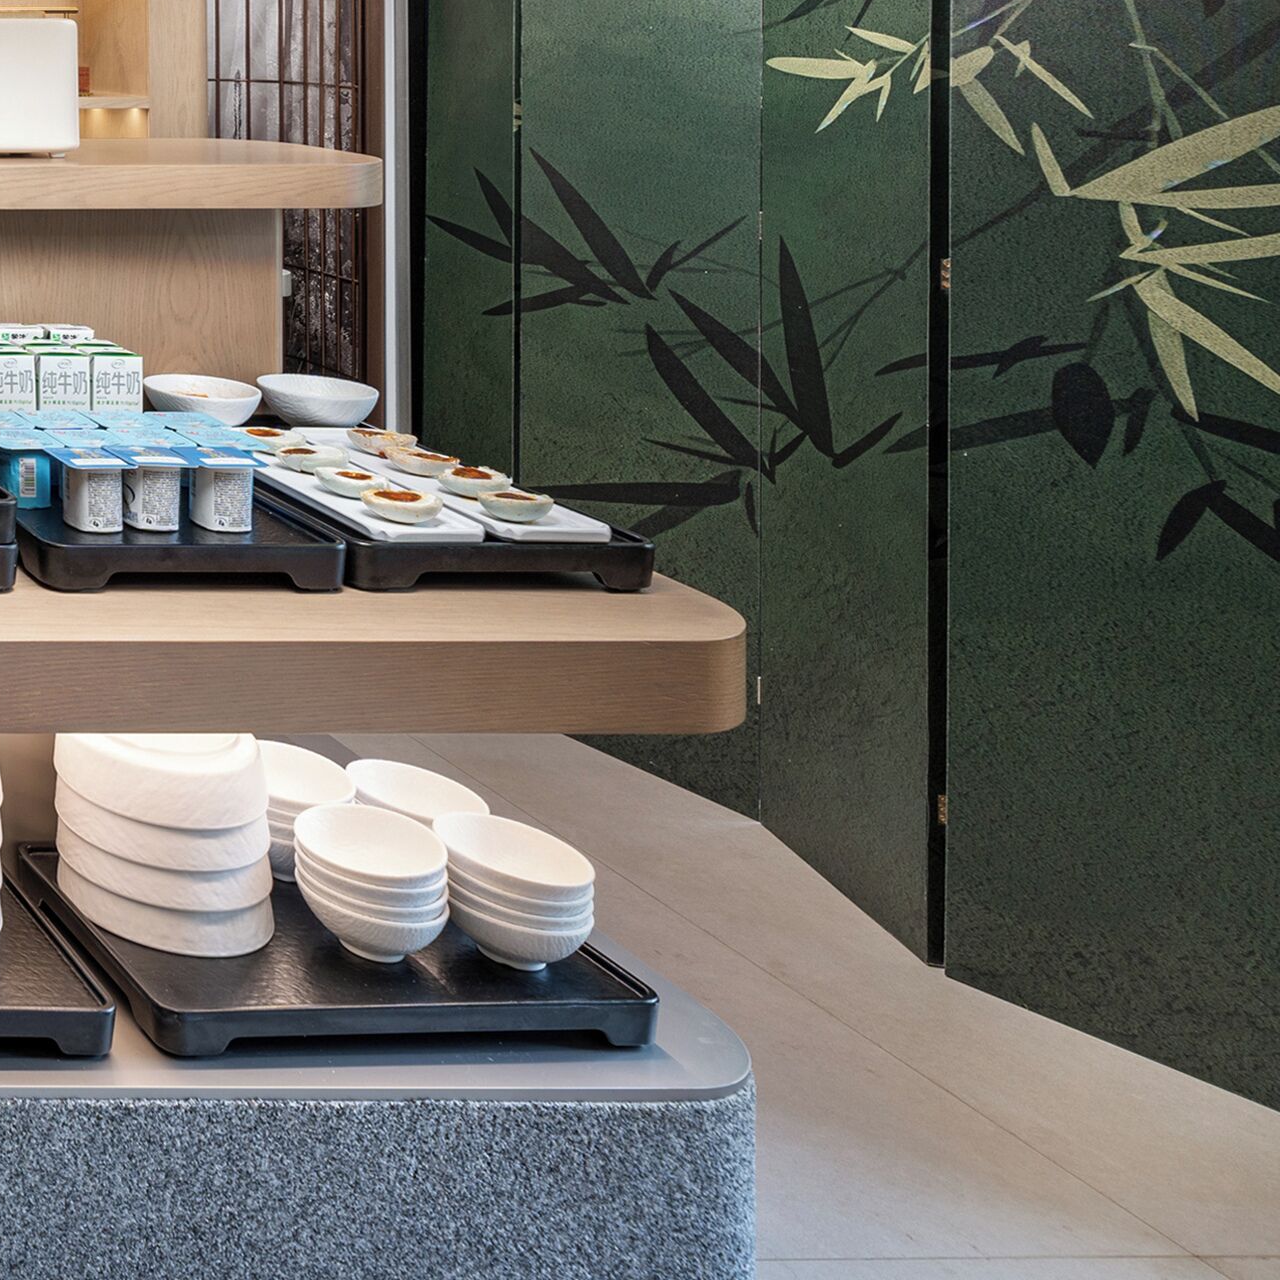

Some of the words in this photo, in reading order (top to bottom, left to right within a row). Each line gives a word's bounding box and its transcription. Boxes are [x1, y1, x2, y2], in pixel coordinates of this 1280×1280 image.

[42, 370, 88, 395] 纯牛奶
[96, 370, 141, 395] 纯牛奶
